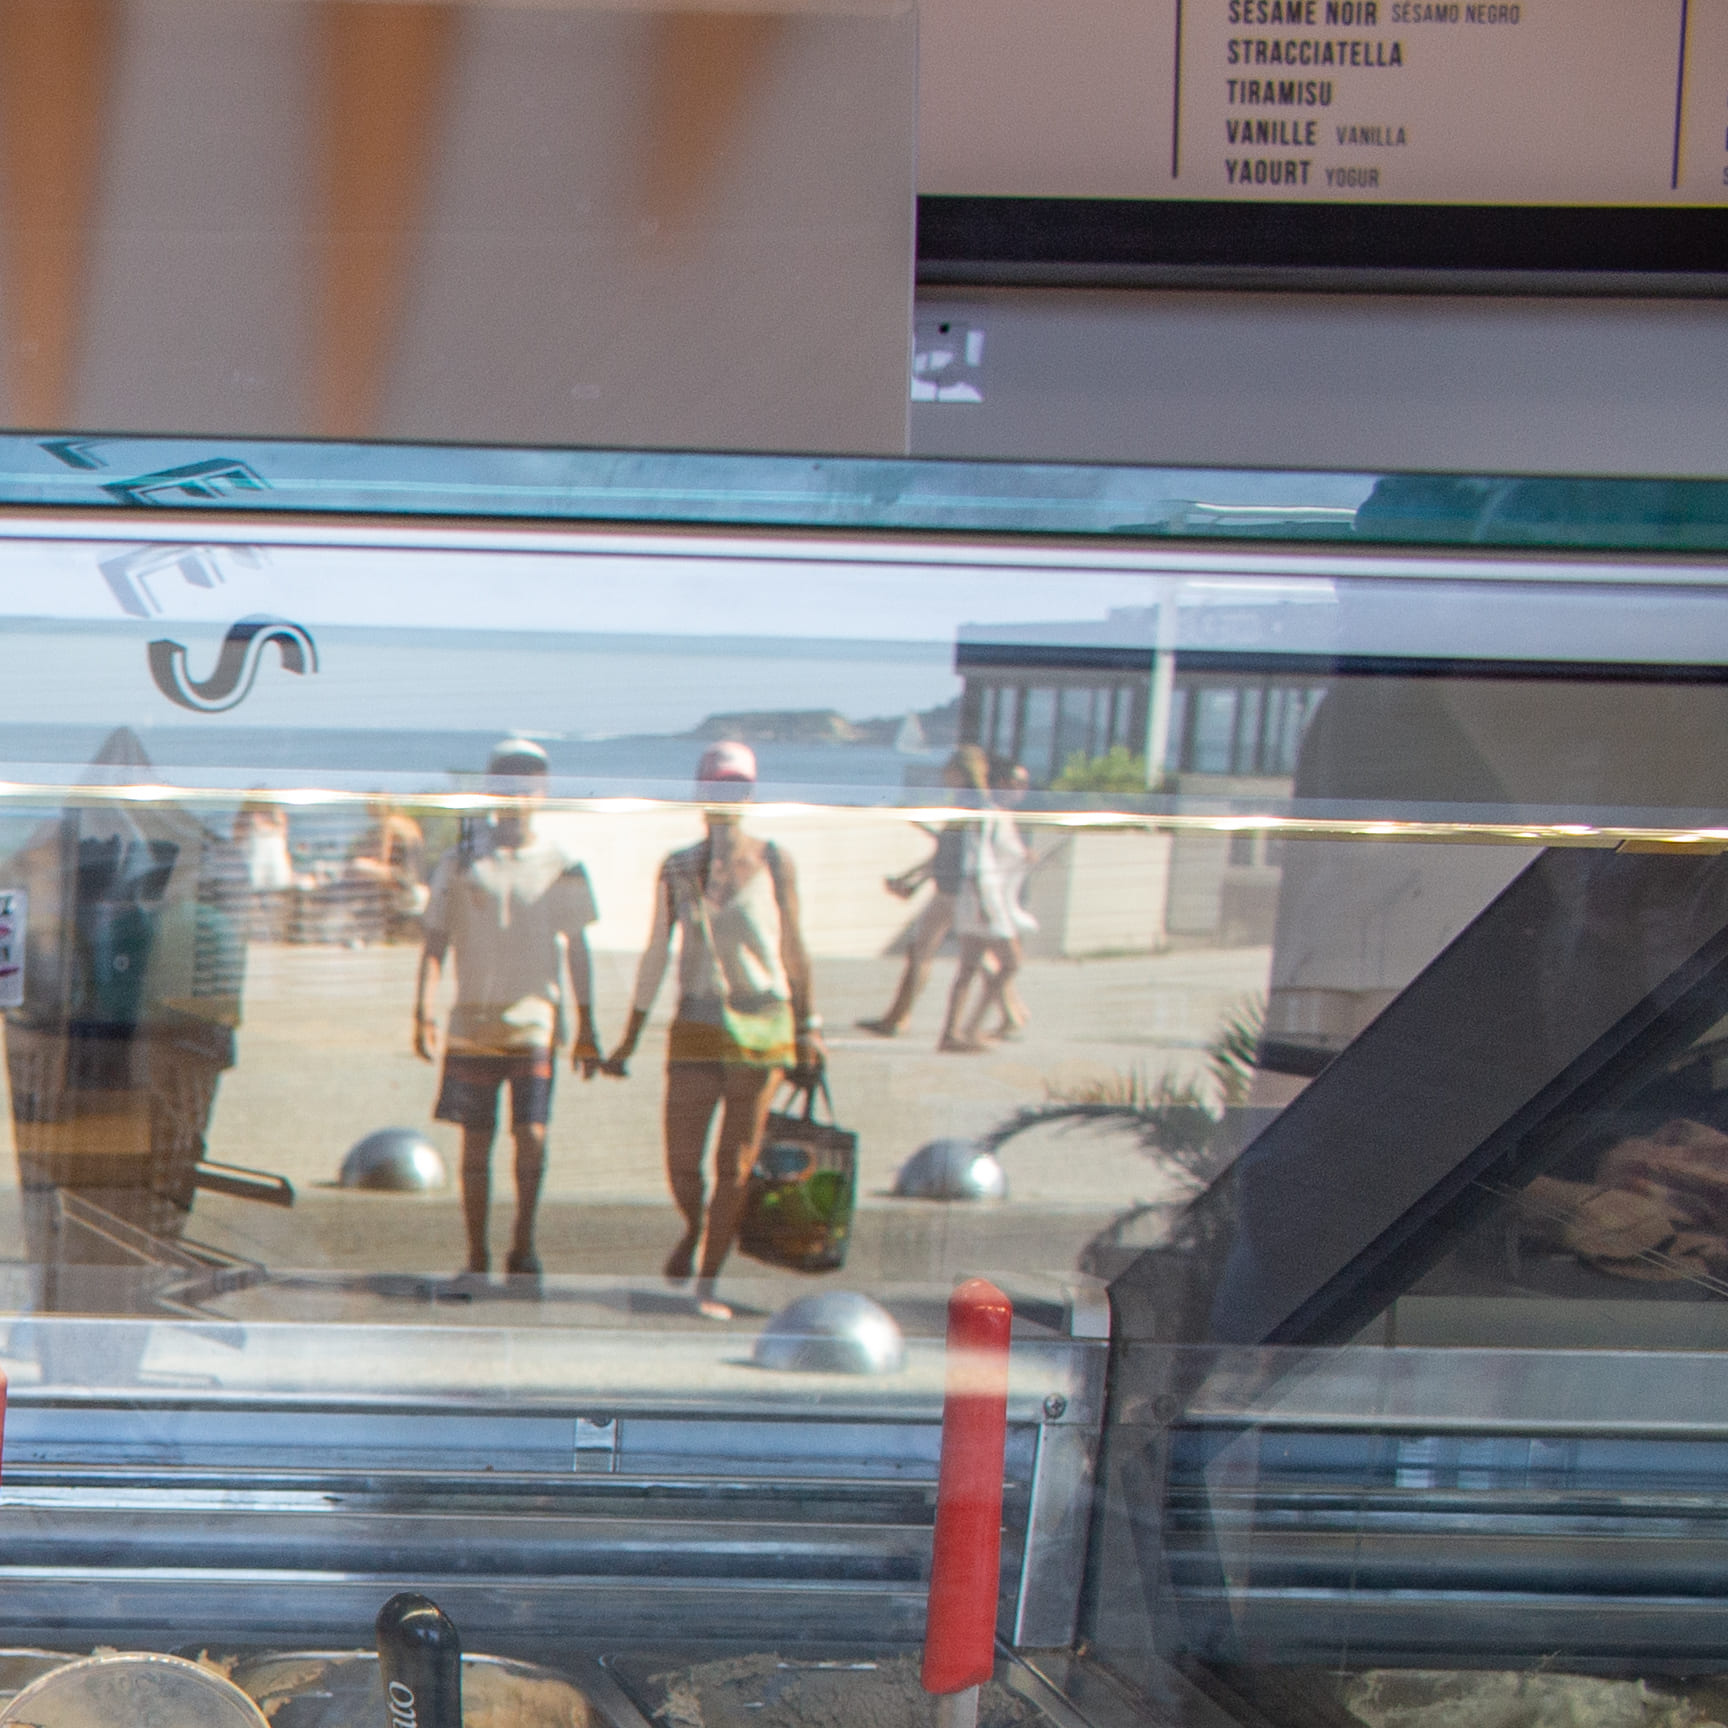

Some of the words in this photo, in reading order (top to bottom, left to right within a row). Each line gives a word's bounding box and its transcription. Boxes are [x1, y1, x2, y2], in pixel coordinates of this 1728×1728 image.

[1326, 0, 1378, 26] NOIR
[1464, 5, 1520, 25] NEGRO
[1227, 39, 1403, 67] STRACCIATELLA
[1227, 79, 1332, 106] TIRAMISU
[1226, 120, 1316, 146] VANILLE
[1336, 126, 1407, 146] VANILLA
[1225, 159, 1311, 186] YAOURT
[1325, 167, 1379, 187] YOGUR
